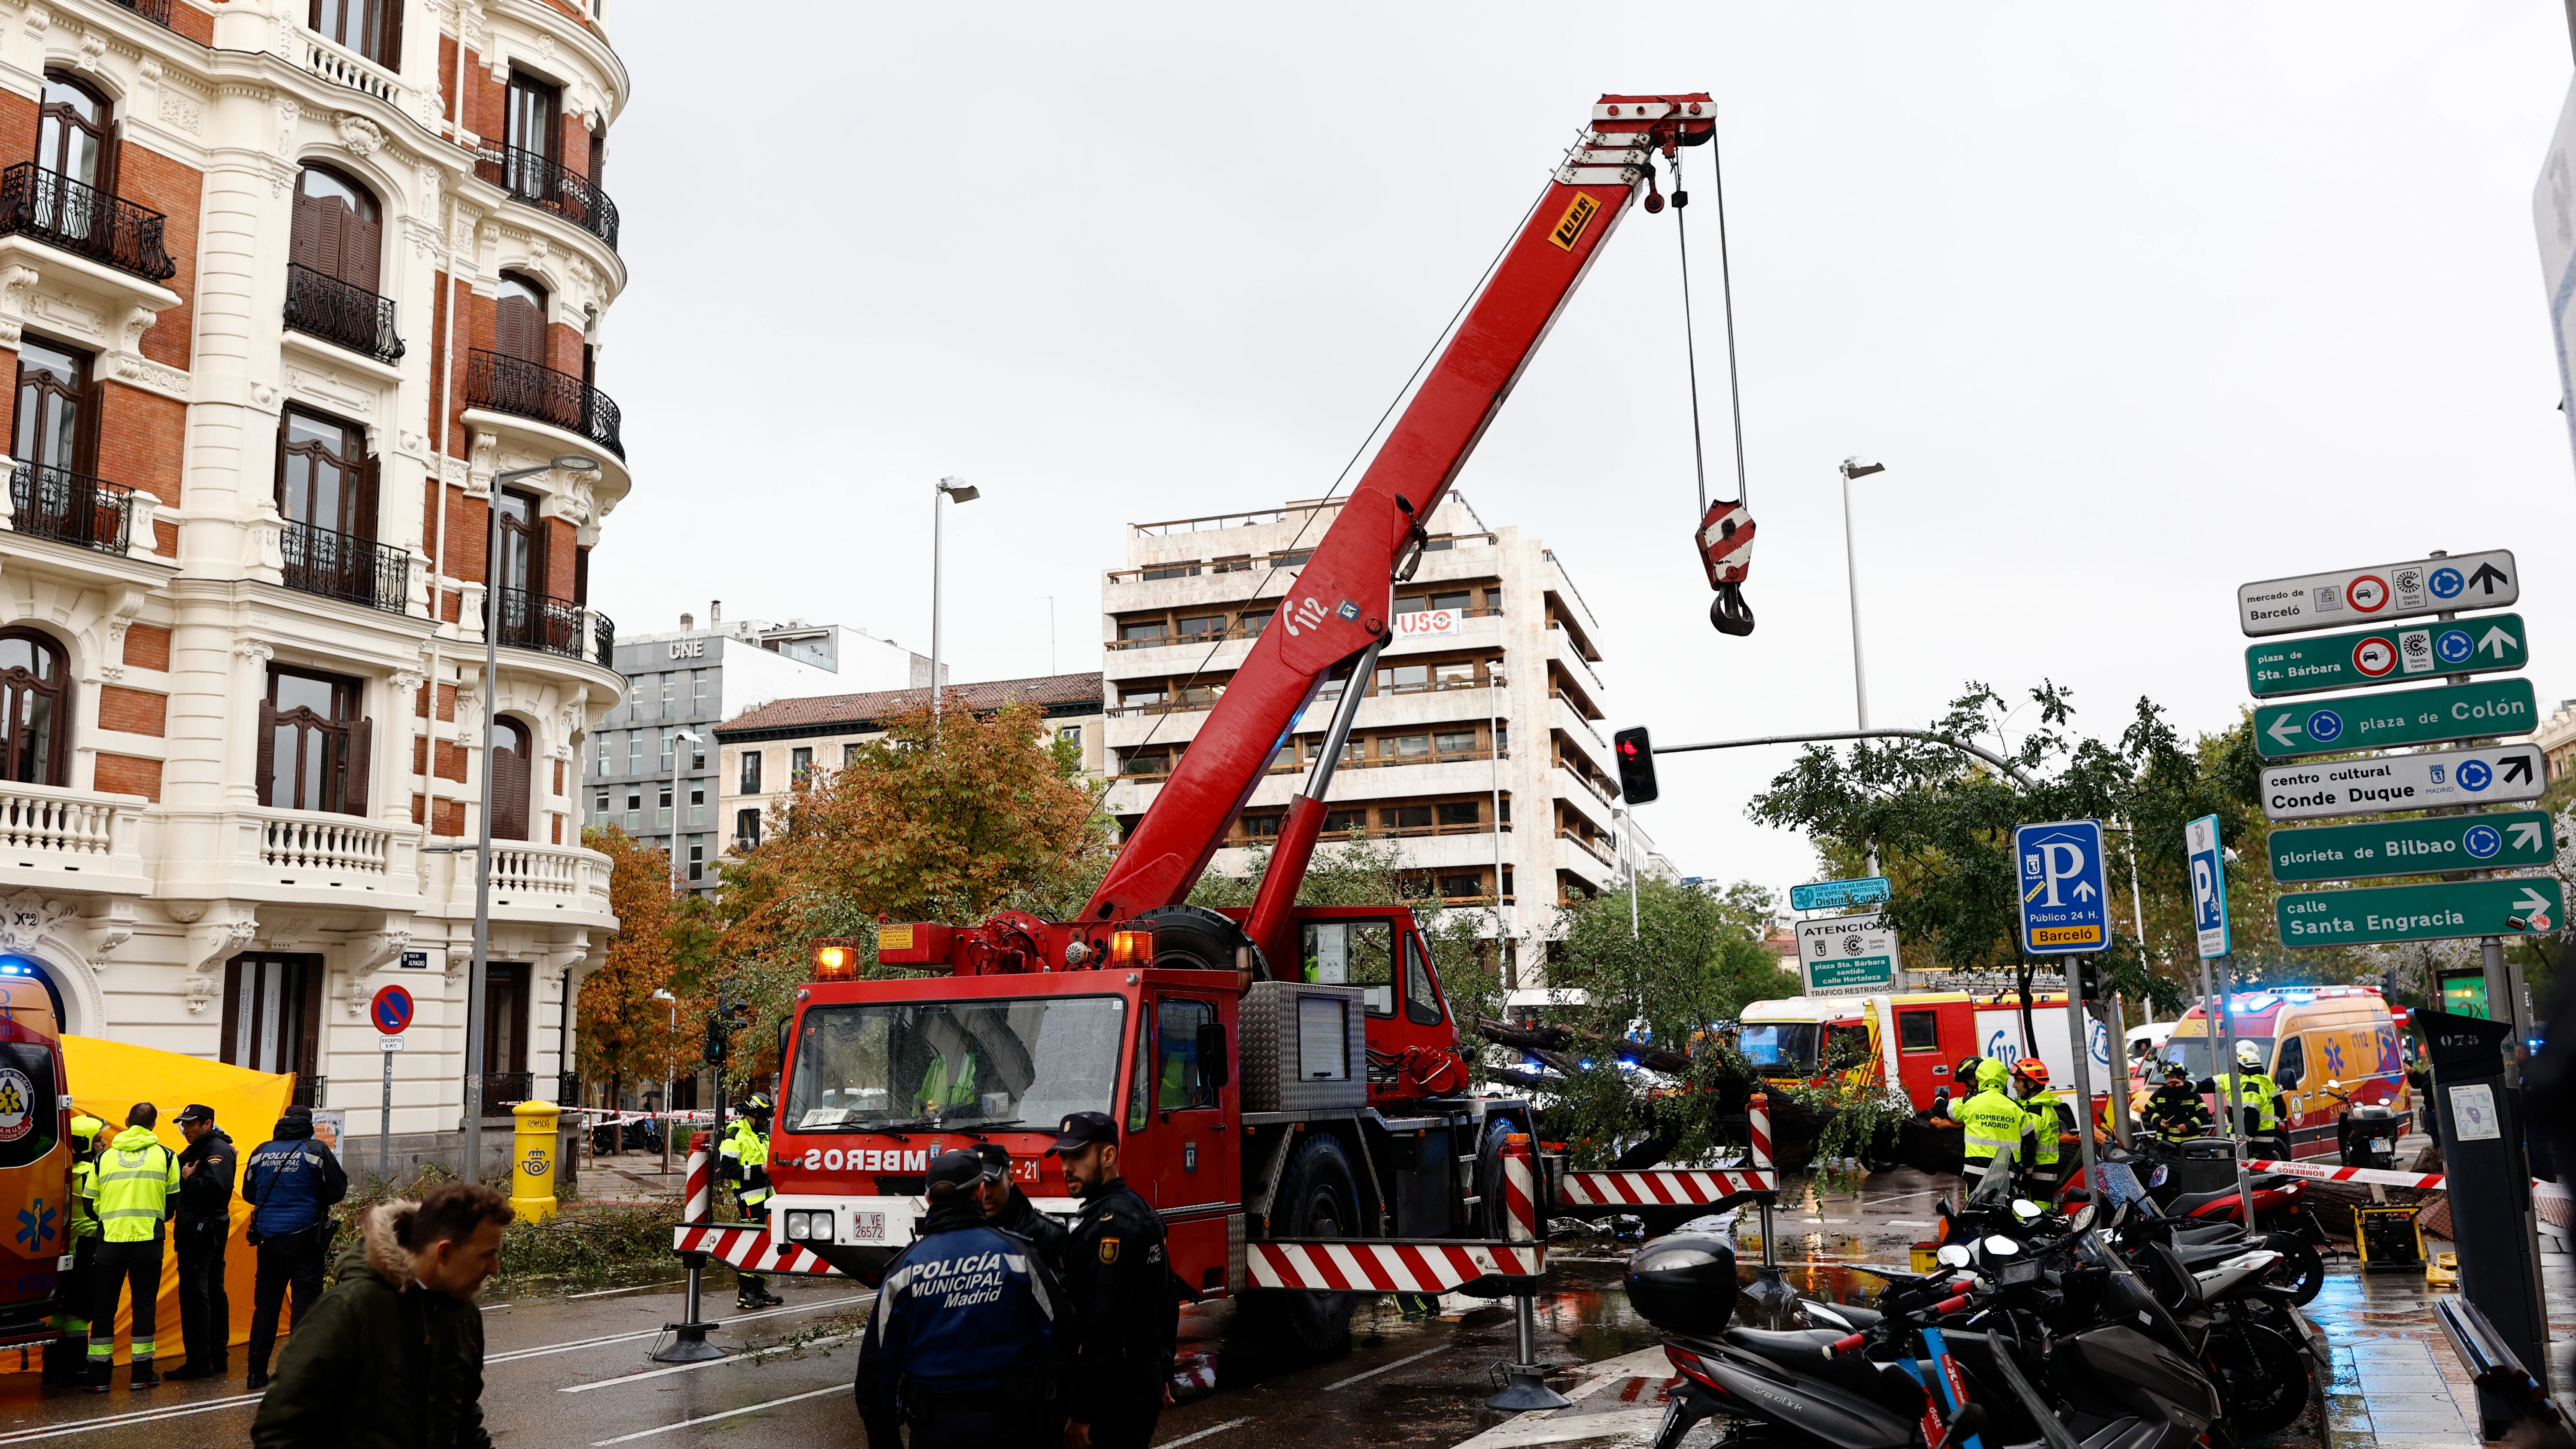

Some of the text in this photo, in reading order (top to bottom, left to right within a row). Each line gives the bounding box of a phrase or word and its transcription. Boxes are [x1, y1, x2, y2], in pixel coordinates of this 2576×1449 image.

[1555, 197, 1594, 246] LUNA
[2247, 589, 2304, 603] mercado de
[1294, 597, 1329, 631] 112
[2250, 605, 2300, 621] Barceló
[1401, 611, 1451, 633] USO
[2258, 650, 2303, 664] plaza de
[2257, 661, 2342, 681] Sta. Bárbara
[2360, 697, 2526, 733] plaza de Colón
[2271, 766, 2392, 787] centro cultural
[2272, 785, 2415, 810] Conde Duque
[2426, 786, 2454, 795] MADRID
[2280, 839, 2456, 866] glorieta de Bilbao
[2031, 882, 2044, 895] MULTAS
[1816, 896, 1850, 906] Distrito
[2287, 900, 2327, 914] calle
[2030, 911, 2099, 922] Público 24 H.
[2290, 909, 2465, 936] Santa Engracia
[2040, 928, 2092, 942] Barceló
[1844, 974, 1881, 982] Hortaleza
[1810, 988, 1843, 997] TRÁFICO
[2440, 1035, 2479, 1046] 075
[1996, 1045, 2017, 1069] 112
[14, 1072, 33, 1094] madrid
[1975, 1114, 2016, 1123] BOMBEROS
[1981, 1121, 2010, 1130] MADRID
[18, 1126, 30, 1136] CIVIL
[261, 1150, 302, 1160] POLICÍA
[1024, 1160, 1037, 1180] 21
[2277, 1167, 2325, 1177] BOMBEROS
[855, 1214, 881, 1225] M VE
[855, 1226, 883, 1239] 26572
[911, 1251, 1001, 1283] POLICÍA
[911, 1270, 1003, 1298] MUNICIPAL
[2197, 1273, 2223, 1282] RZA
[944, 1287, 1002, 1309] Madrid
[1929, 1407, 1943, 1429] dott
